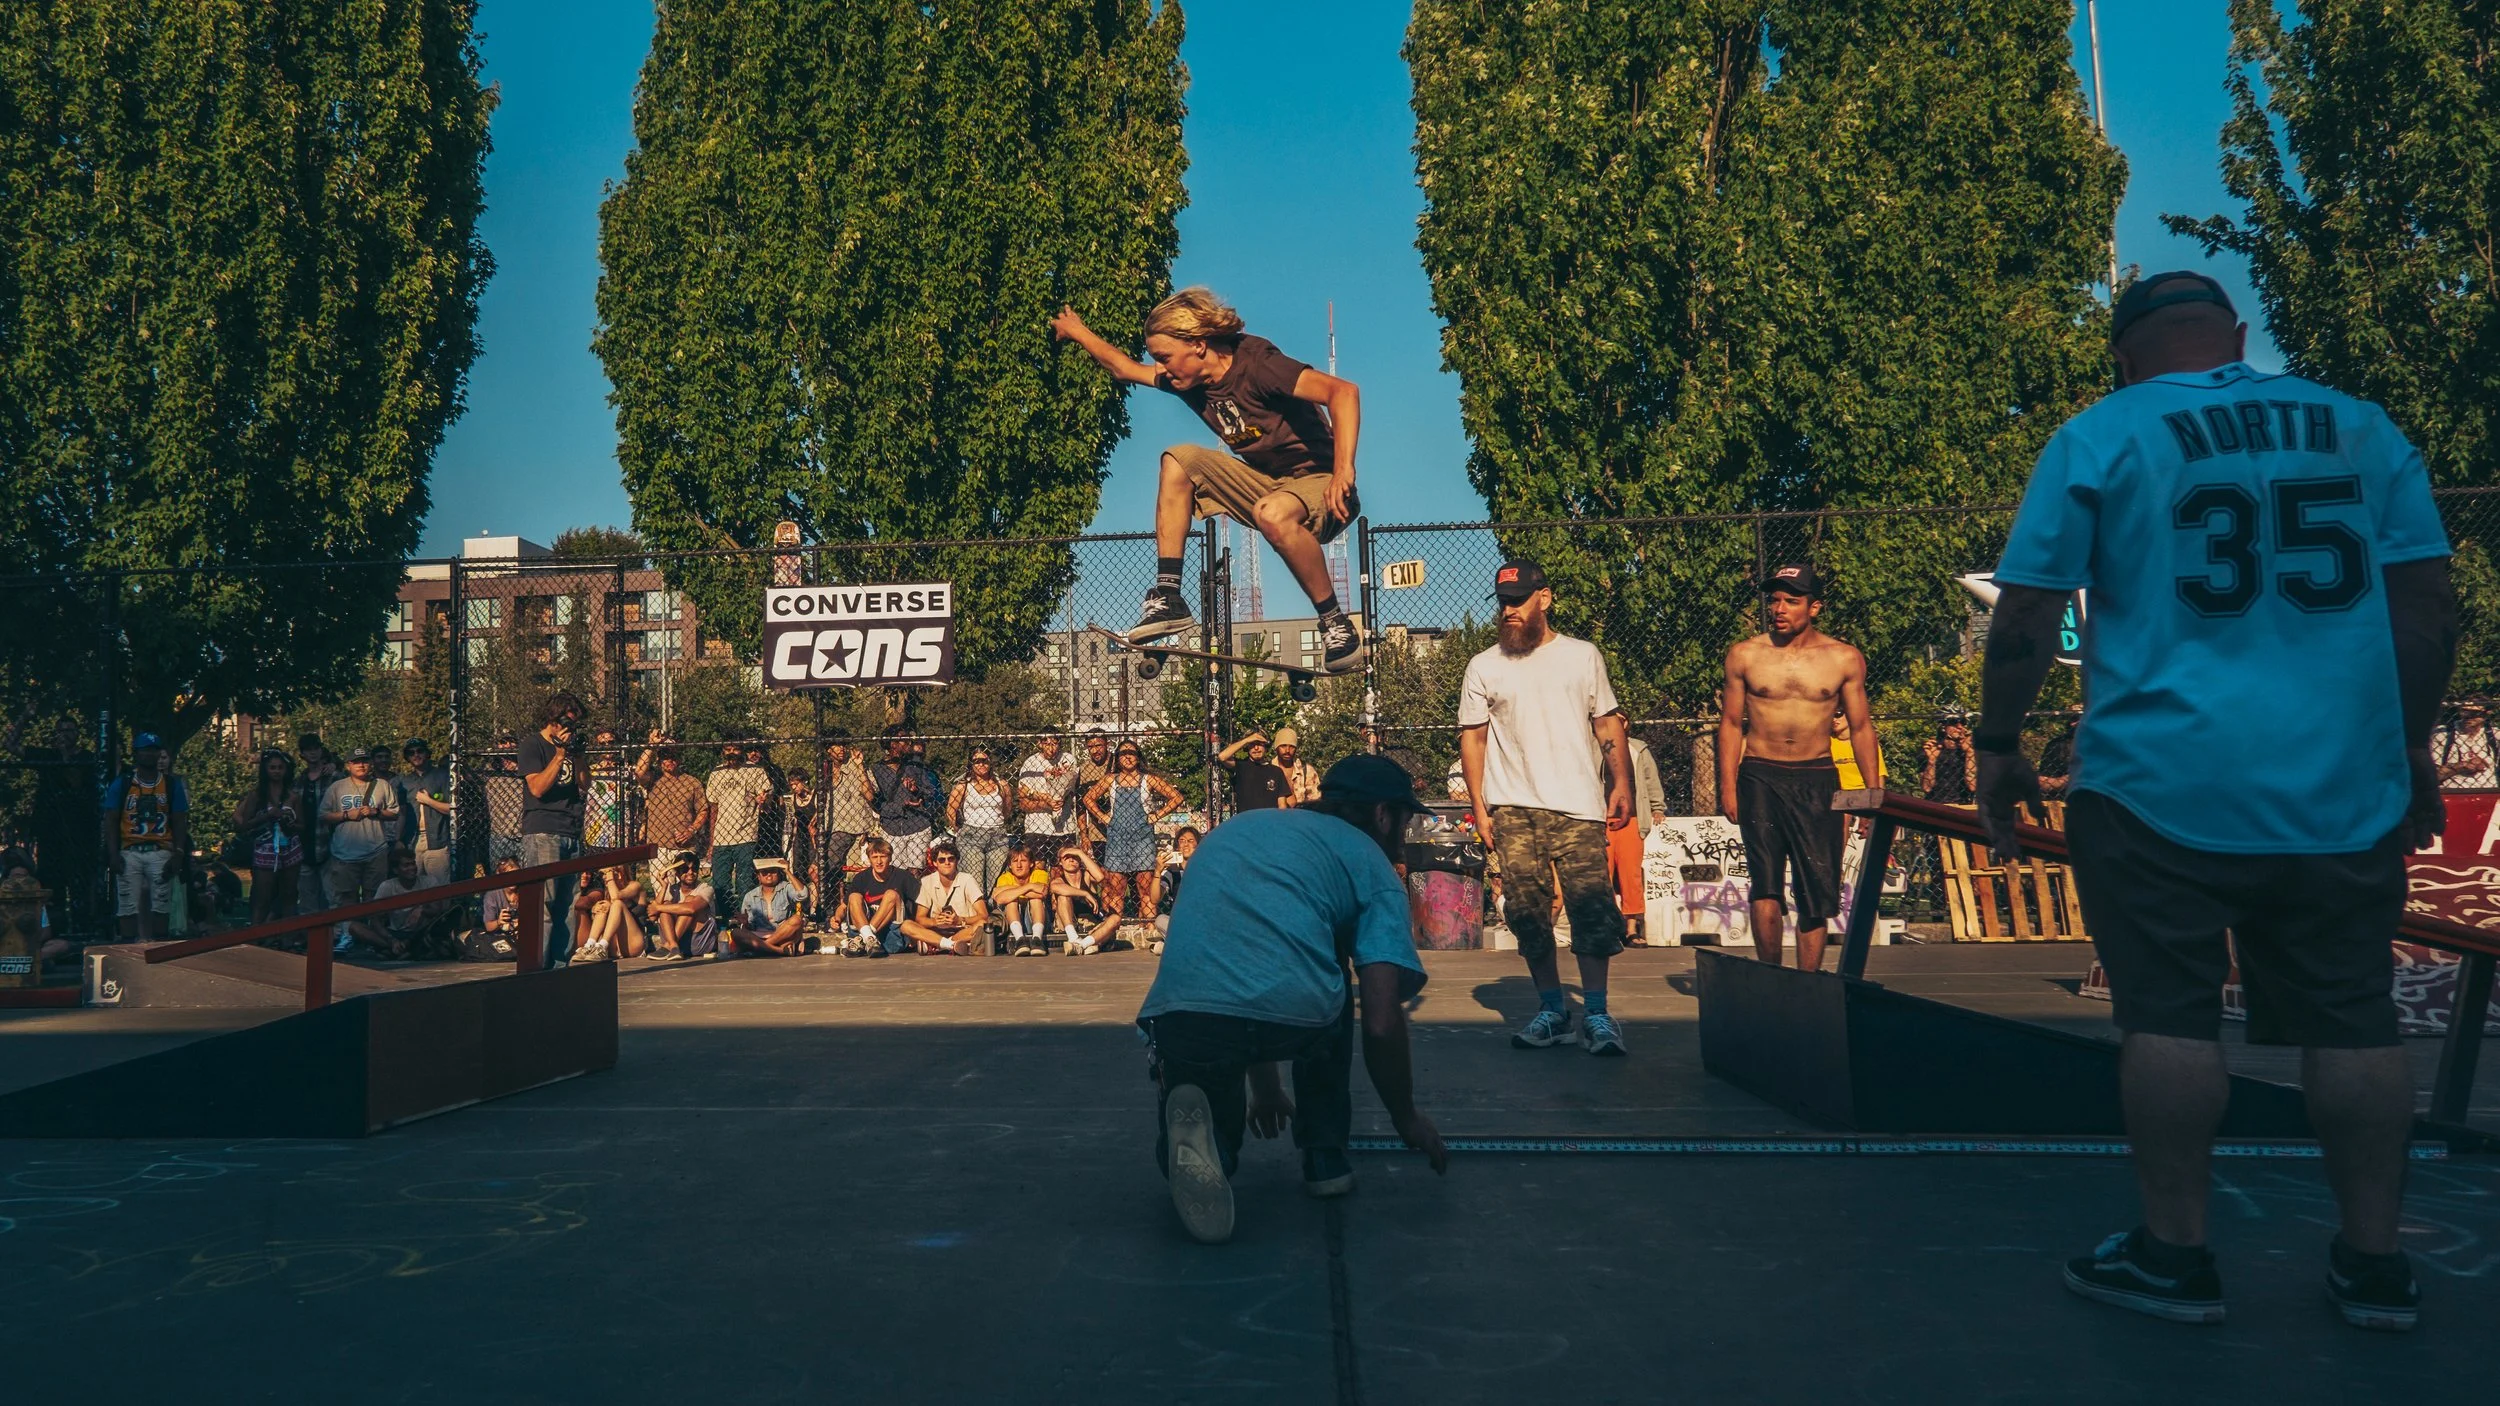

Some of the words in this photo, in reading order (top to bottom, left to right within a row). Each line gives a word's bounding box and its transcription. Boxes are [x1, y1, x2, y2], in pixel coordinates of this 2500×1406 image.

[2162, 400, 2337, 464] NORTH
[2172, 474, 2373, 619] 35
[1391, 562, 1418, 586] EXIT
[772, 590, 945, 616] CONVERSE
